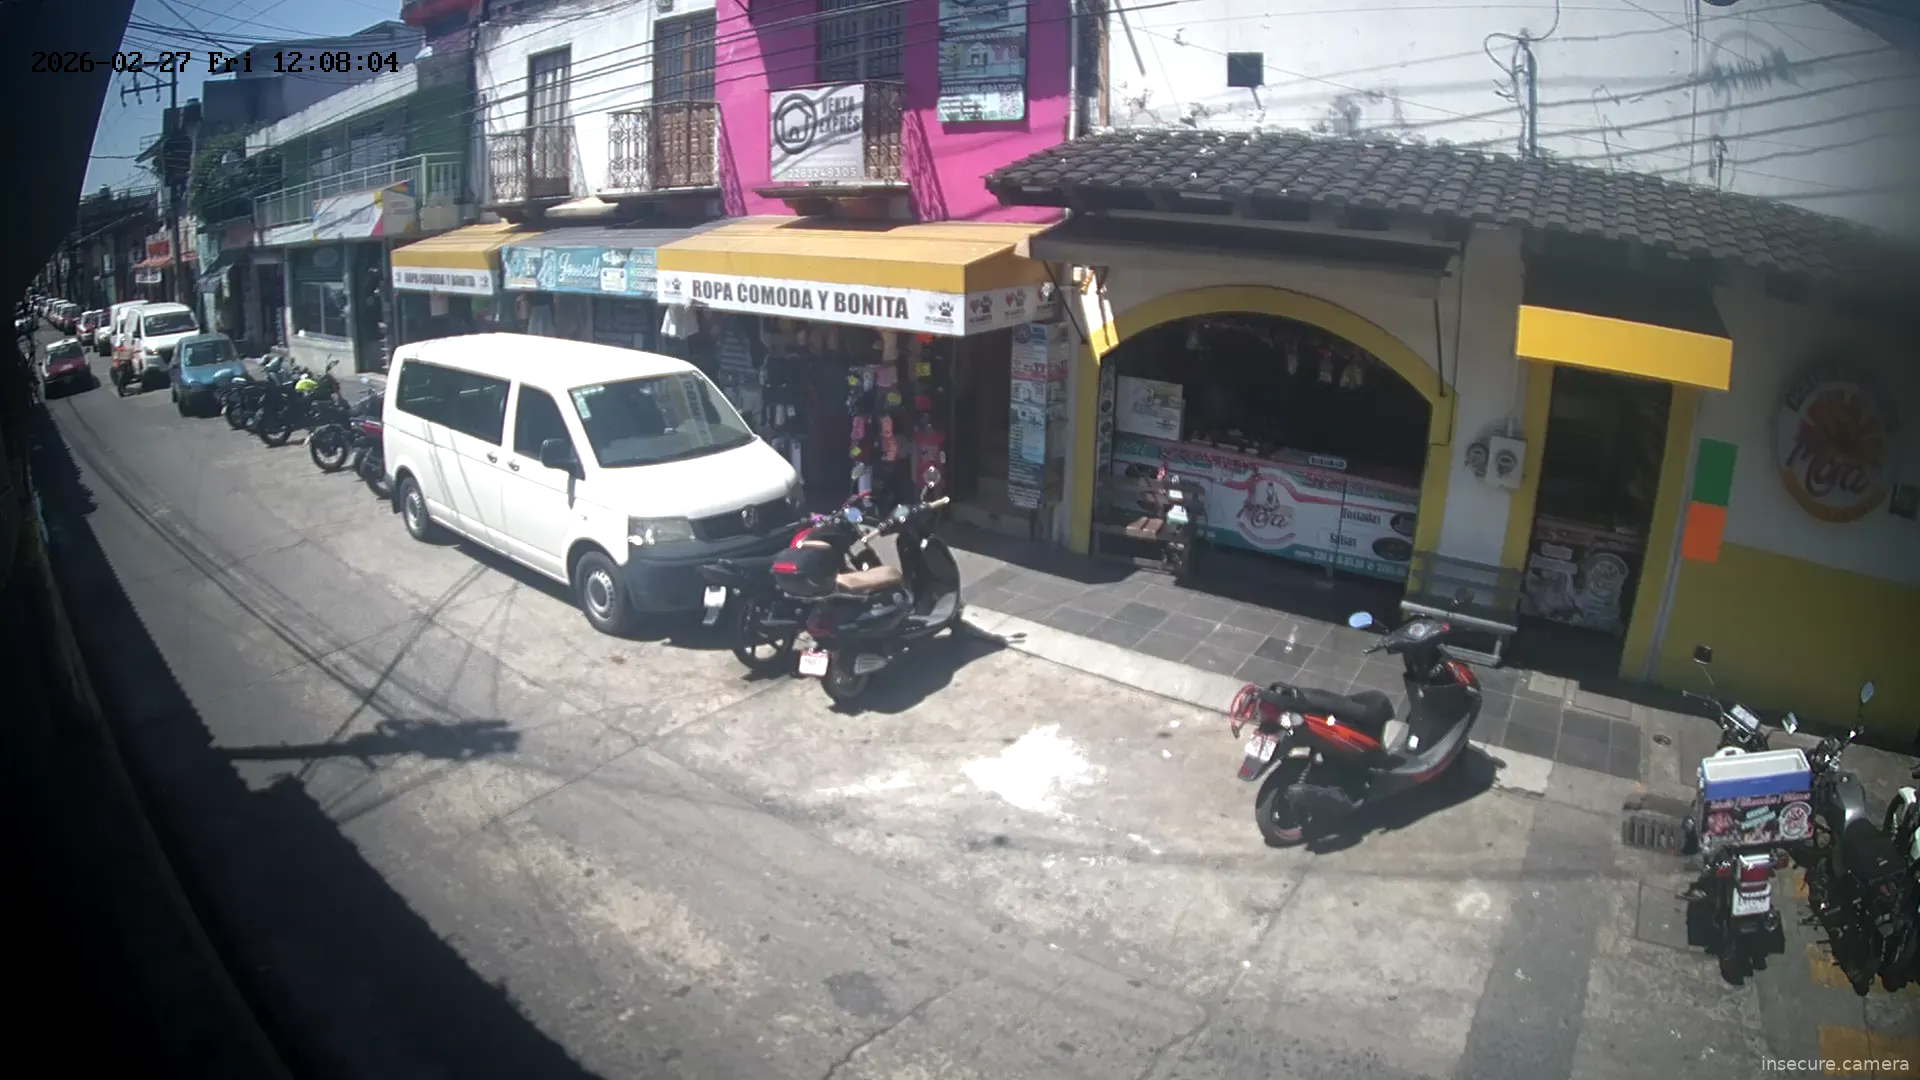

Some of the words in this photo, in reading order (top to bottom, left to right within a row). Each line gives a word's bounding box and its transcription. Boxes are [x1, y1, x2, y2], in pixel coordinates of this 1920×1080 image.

[821, 96, 855, 114] VENTA
[692, 279, 733, 302] ROPA
[737, 283, 814, 310] COMODA
[817, 290, 831, 310] Y
[834, 292, 910, 320] BONITA
